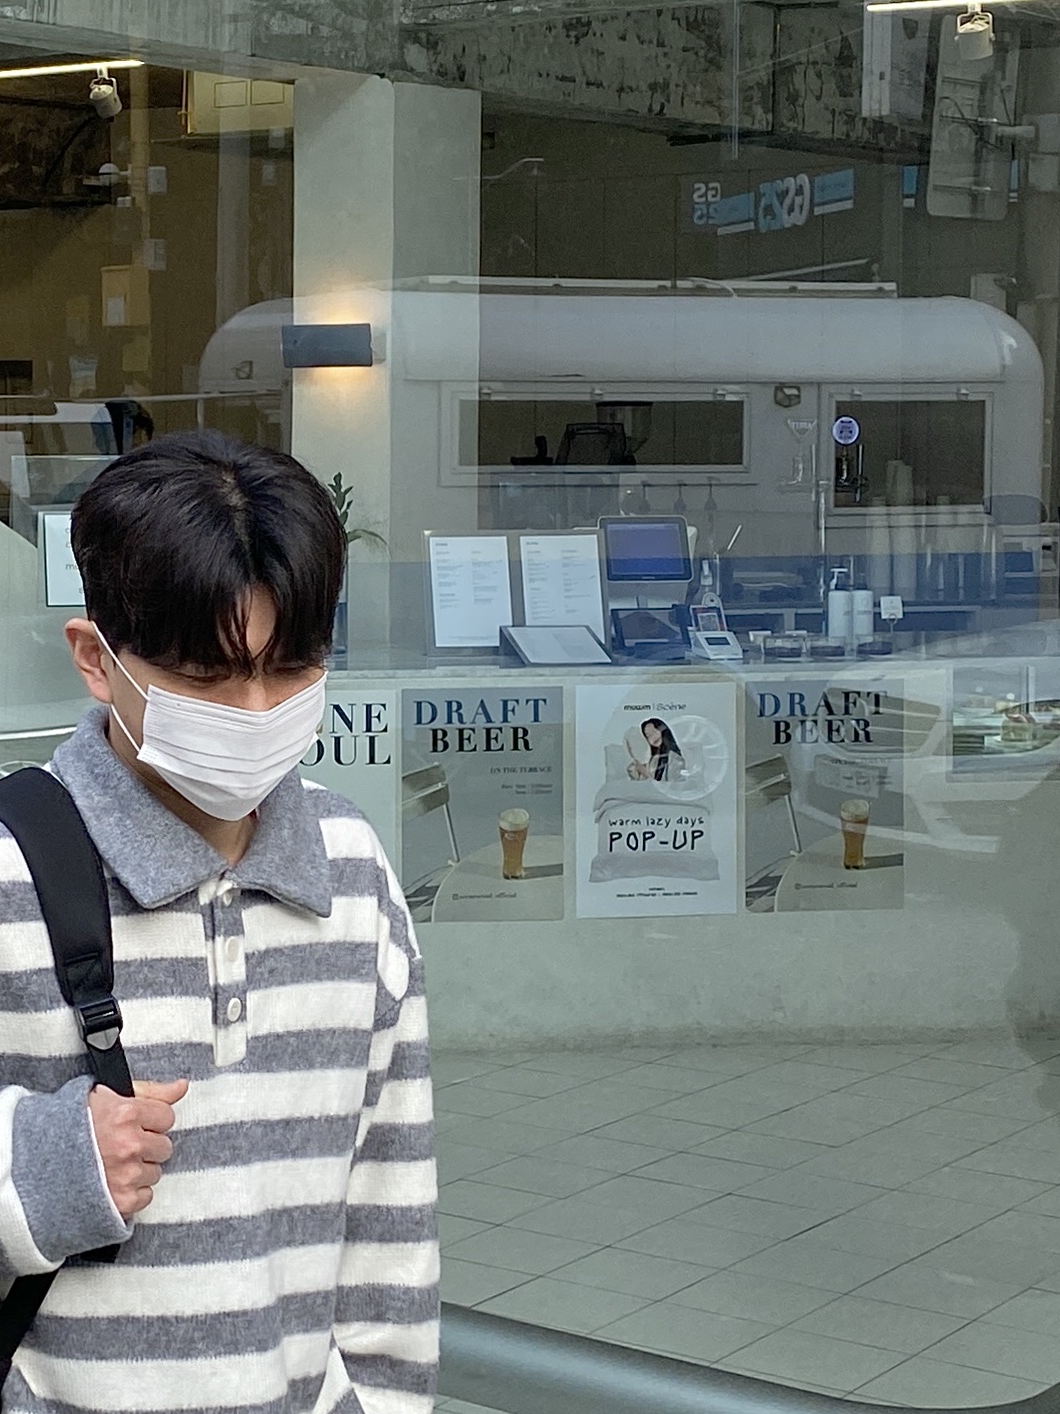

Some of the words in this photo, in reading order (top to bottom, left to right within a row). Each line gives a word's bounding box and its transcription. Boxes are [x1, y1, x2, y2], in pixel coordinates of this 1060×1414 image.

[413, 698, 547, 725] DRAFT
[756, 691, 888, 718] DRAFT
[430, 726, 533, 753] BEER
[772, 718, 874, 745] BEER
[608, 818, 642, 827] warm
[646, 816, 672, 829] lazy
[676, 816, 705, 829] days
[609, 829, 704, 853] POP-UP
